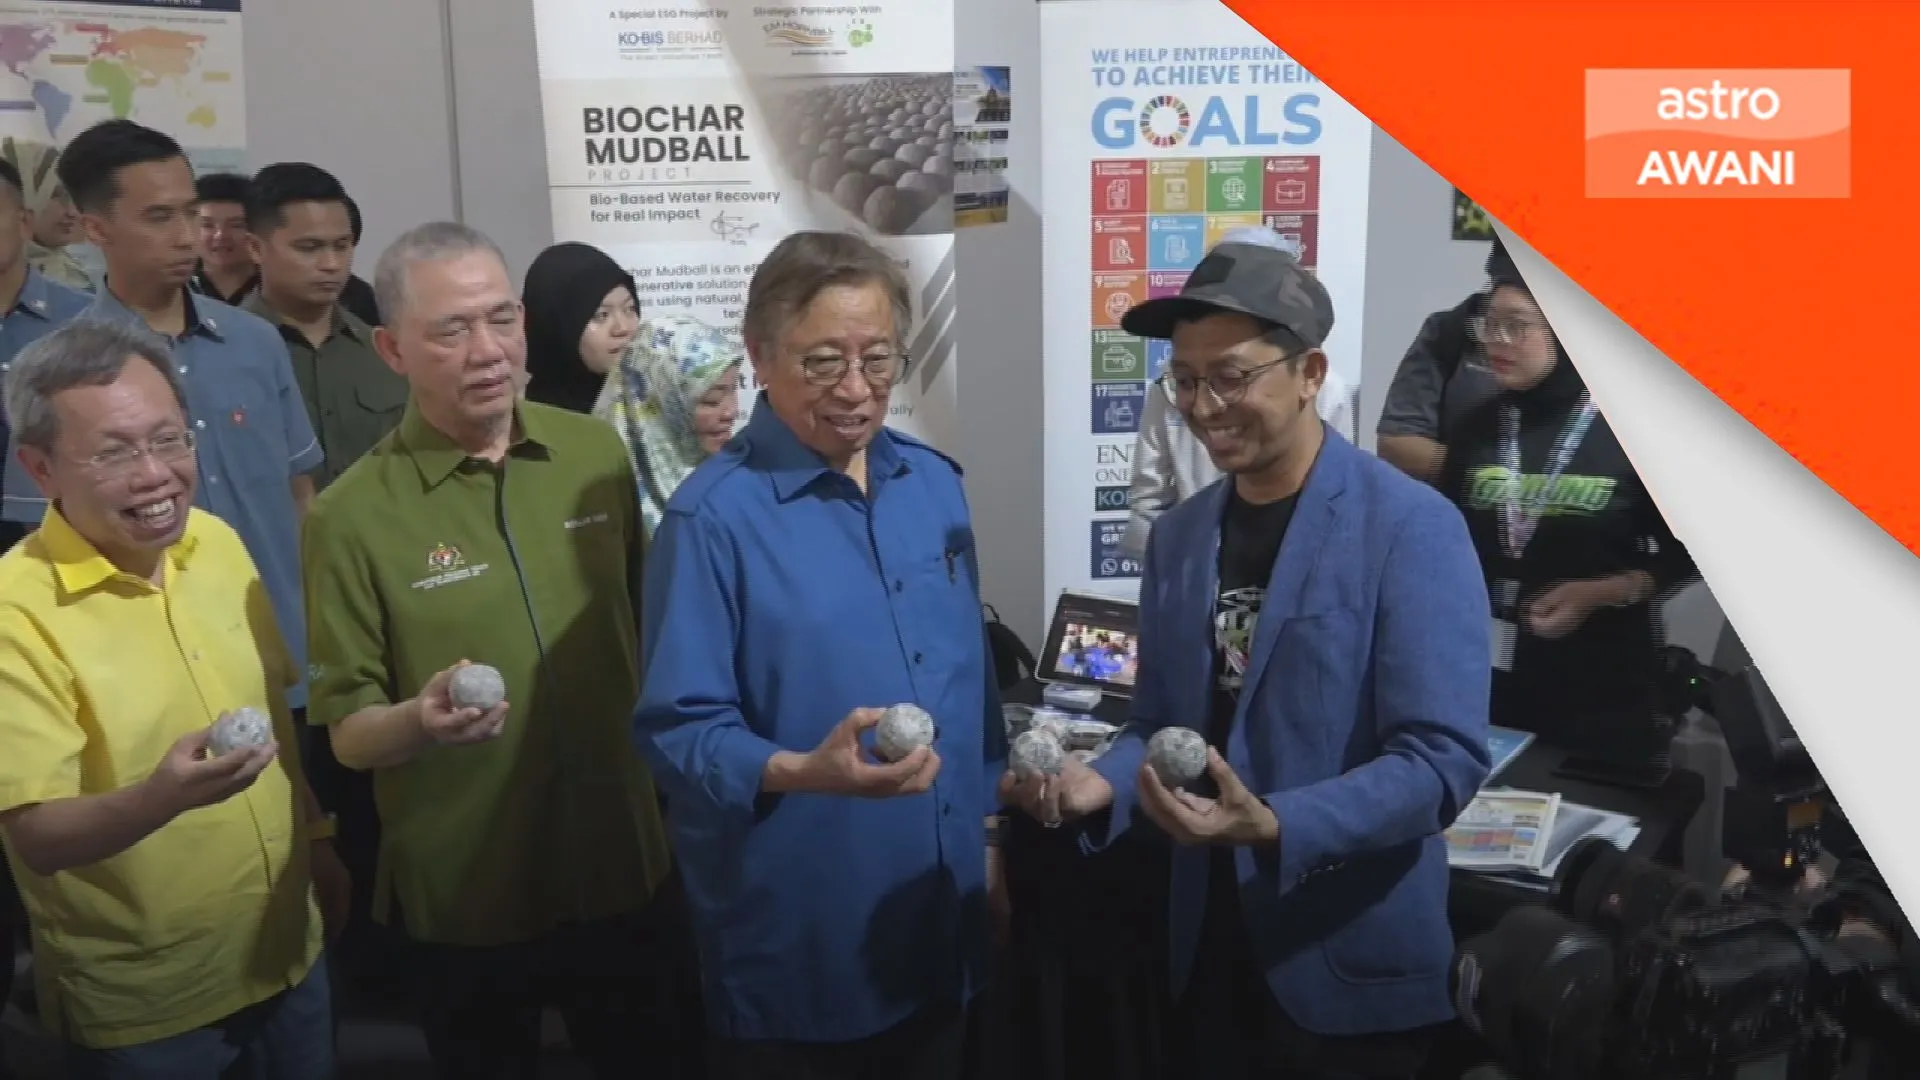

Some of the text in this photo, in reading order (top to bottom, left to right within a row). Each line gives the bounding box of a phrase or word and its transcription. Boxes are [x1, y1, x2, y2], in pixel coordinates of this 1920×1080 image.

[619, 9, 656, 21] Special
[680, 8, 713, 19] Project
[666, 30, 722, 44] BERHAD
[1092, 45, 1297, 64] WE HELP ENTREPRENE
[1092, 67, 1125, 87] TO
[1133, 65, 1240, 86] ACHIEVE
[583, 104, 744, 133] BIOCHAR
[1091, 93, 1323, 149] GOALS
[585, 135, 750, 164] MUDBALL
[1095, 162, 1101, 176] 1
[1151, 161, 1160, 175] 2
[1208, 161, 1217, 174] 3
[1265, 159, 1274, 172] 4
[588, 167, 691, 181] PROJECT
[590, 191, 781, 205] Bio-Based Water Recovery
[590, 208, 701, 223] for Real Impact
[1094, 220, 1102, 233] 5
[656, 264, 708, 276] Mudball
[710, 264, 720, 275] is
[723, 265, 741, 275] an
[1150, 274, 1163, 287] 10
[656, 296, 692, 307] using
[1094, 384, 1108, 397] 17
[890, 404, 913, 417] ally
[1121, 559, 1143, 573] 01
